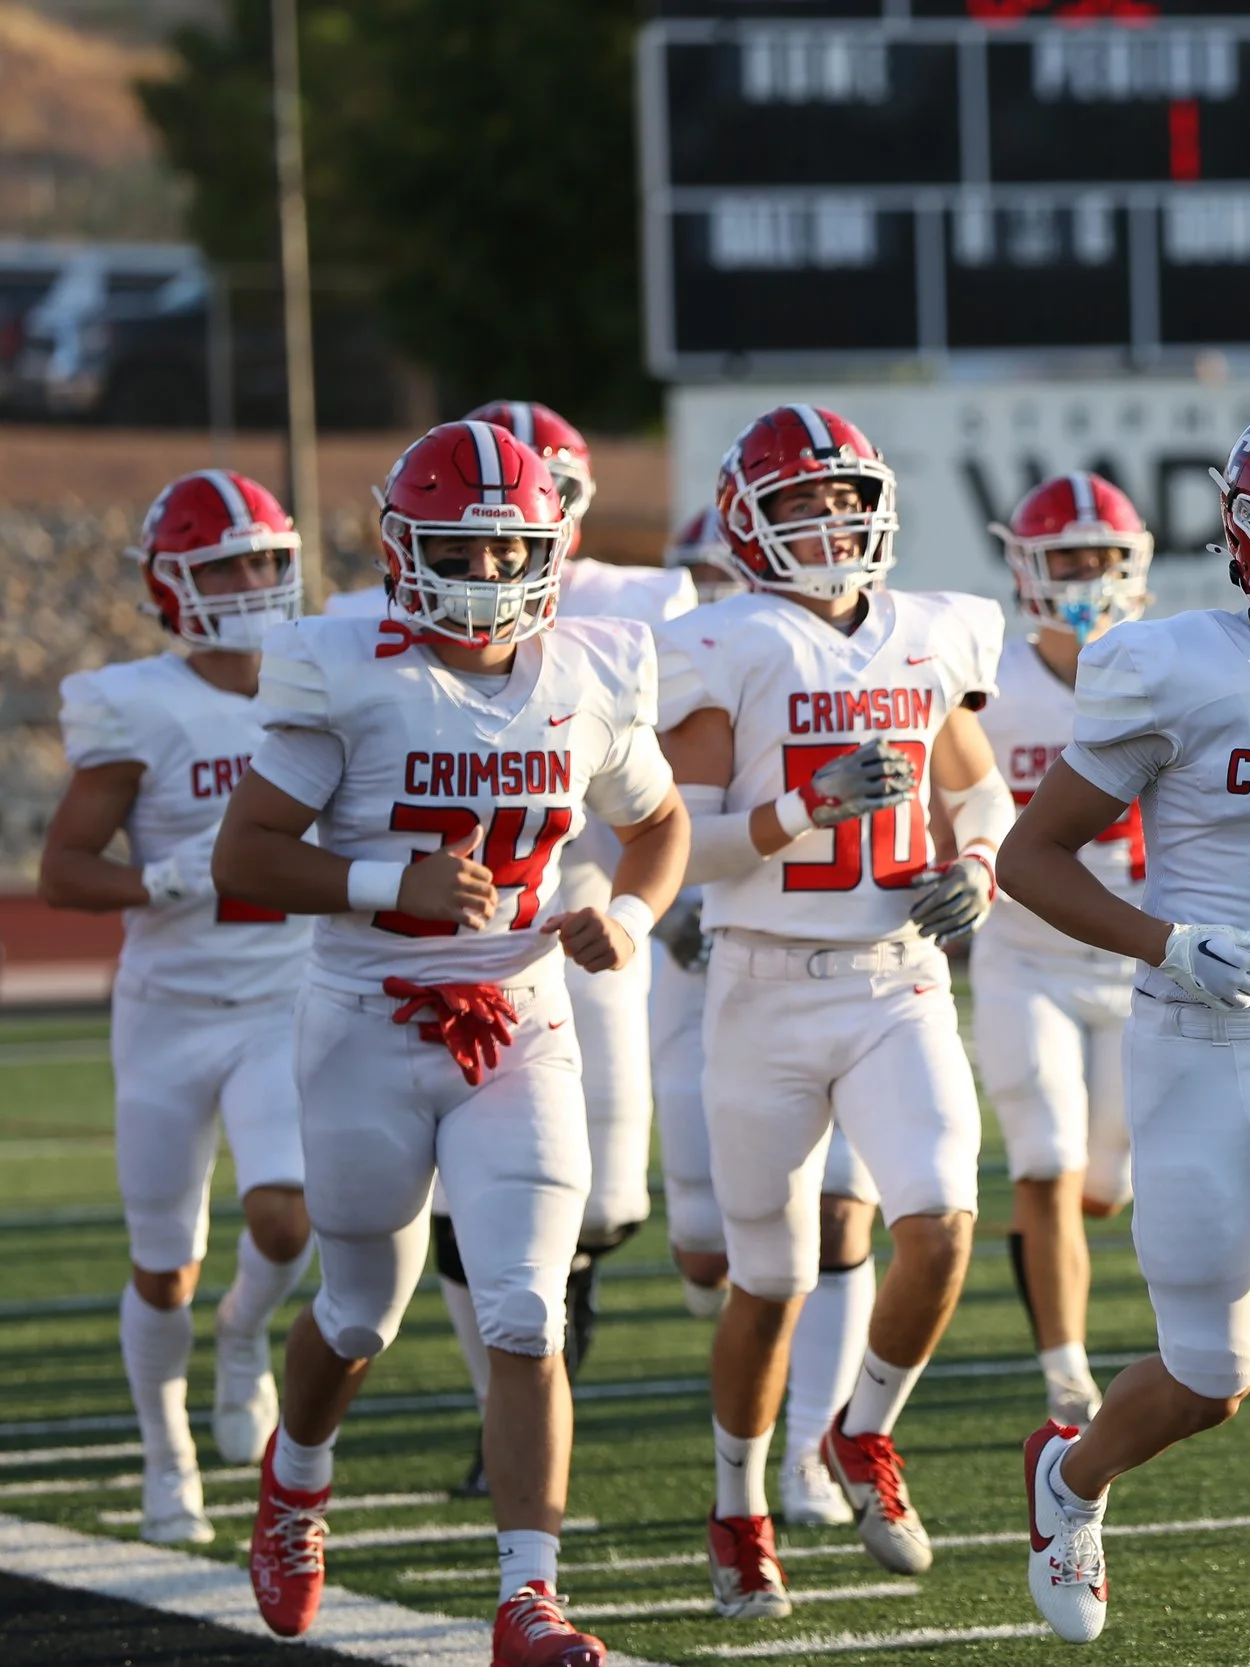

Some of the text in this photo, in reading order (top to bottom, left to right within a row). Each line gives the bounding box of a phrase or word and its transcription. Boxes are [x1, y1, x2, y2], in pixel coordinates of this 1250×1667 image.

[471, 507, 516, 518] Riddell
[788, 688, 932, 735] CRIMSON
[404, 750, 571, 797] CRIMSON
